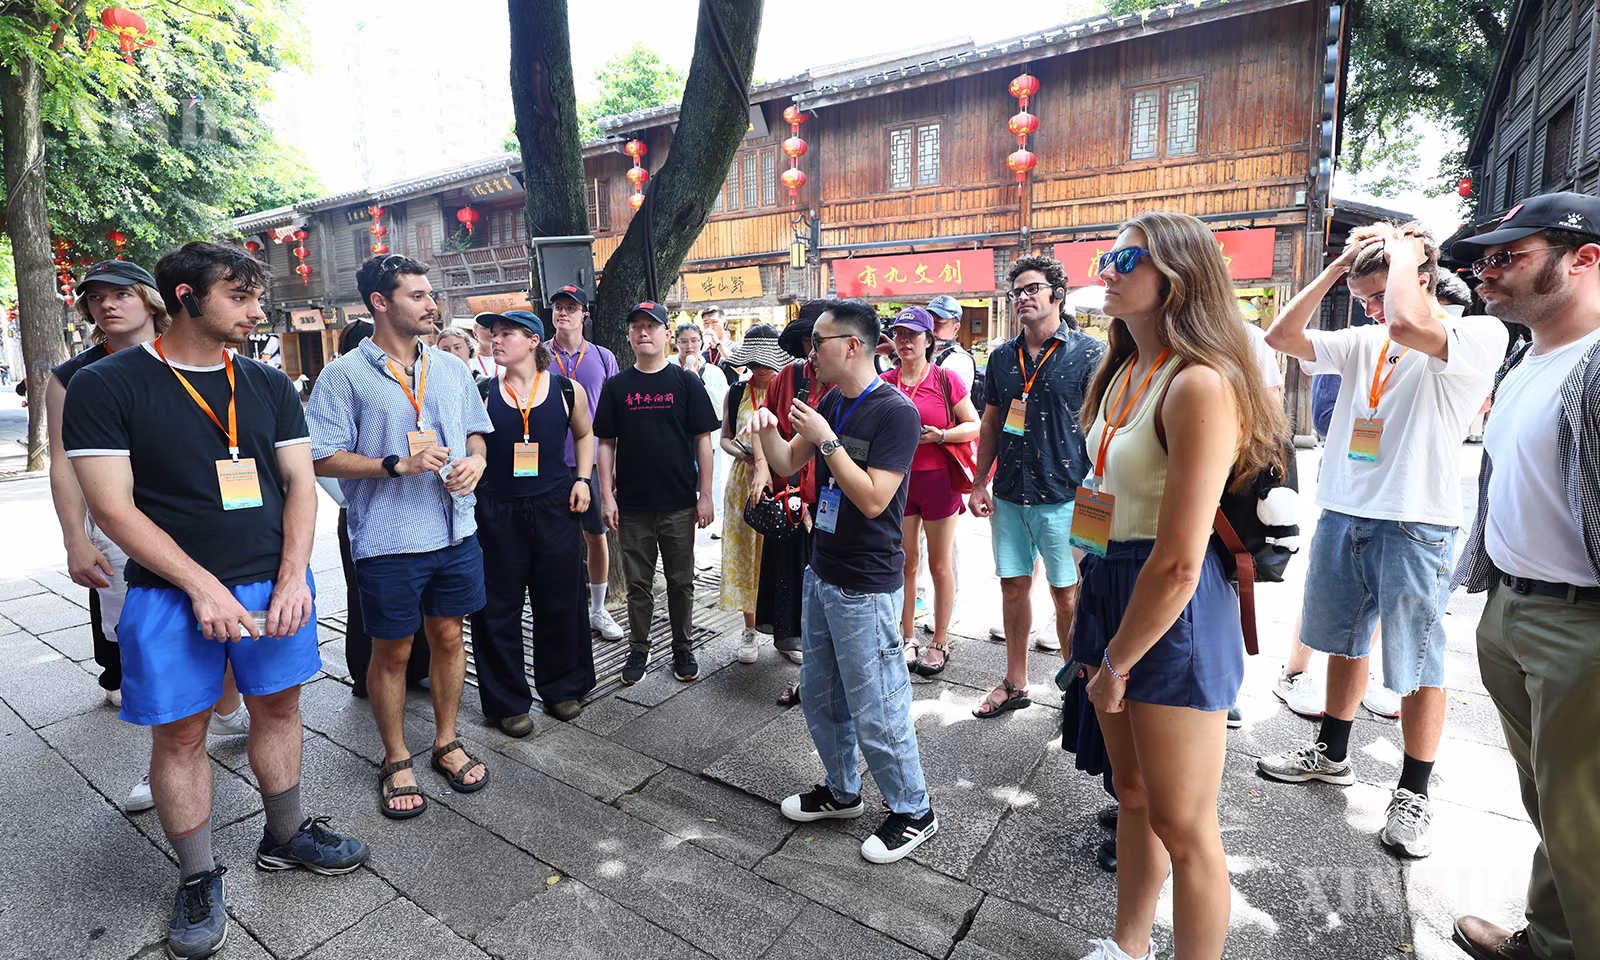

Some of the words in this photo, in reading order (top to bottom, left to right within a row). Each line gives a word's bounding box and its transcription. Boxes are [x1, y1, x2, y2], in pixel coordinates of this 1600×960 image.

[1558, 221, 1582, 229] KELME
[857, 259, 962, 288] 有九文創
